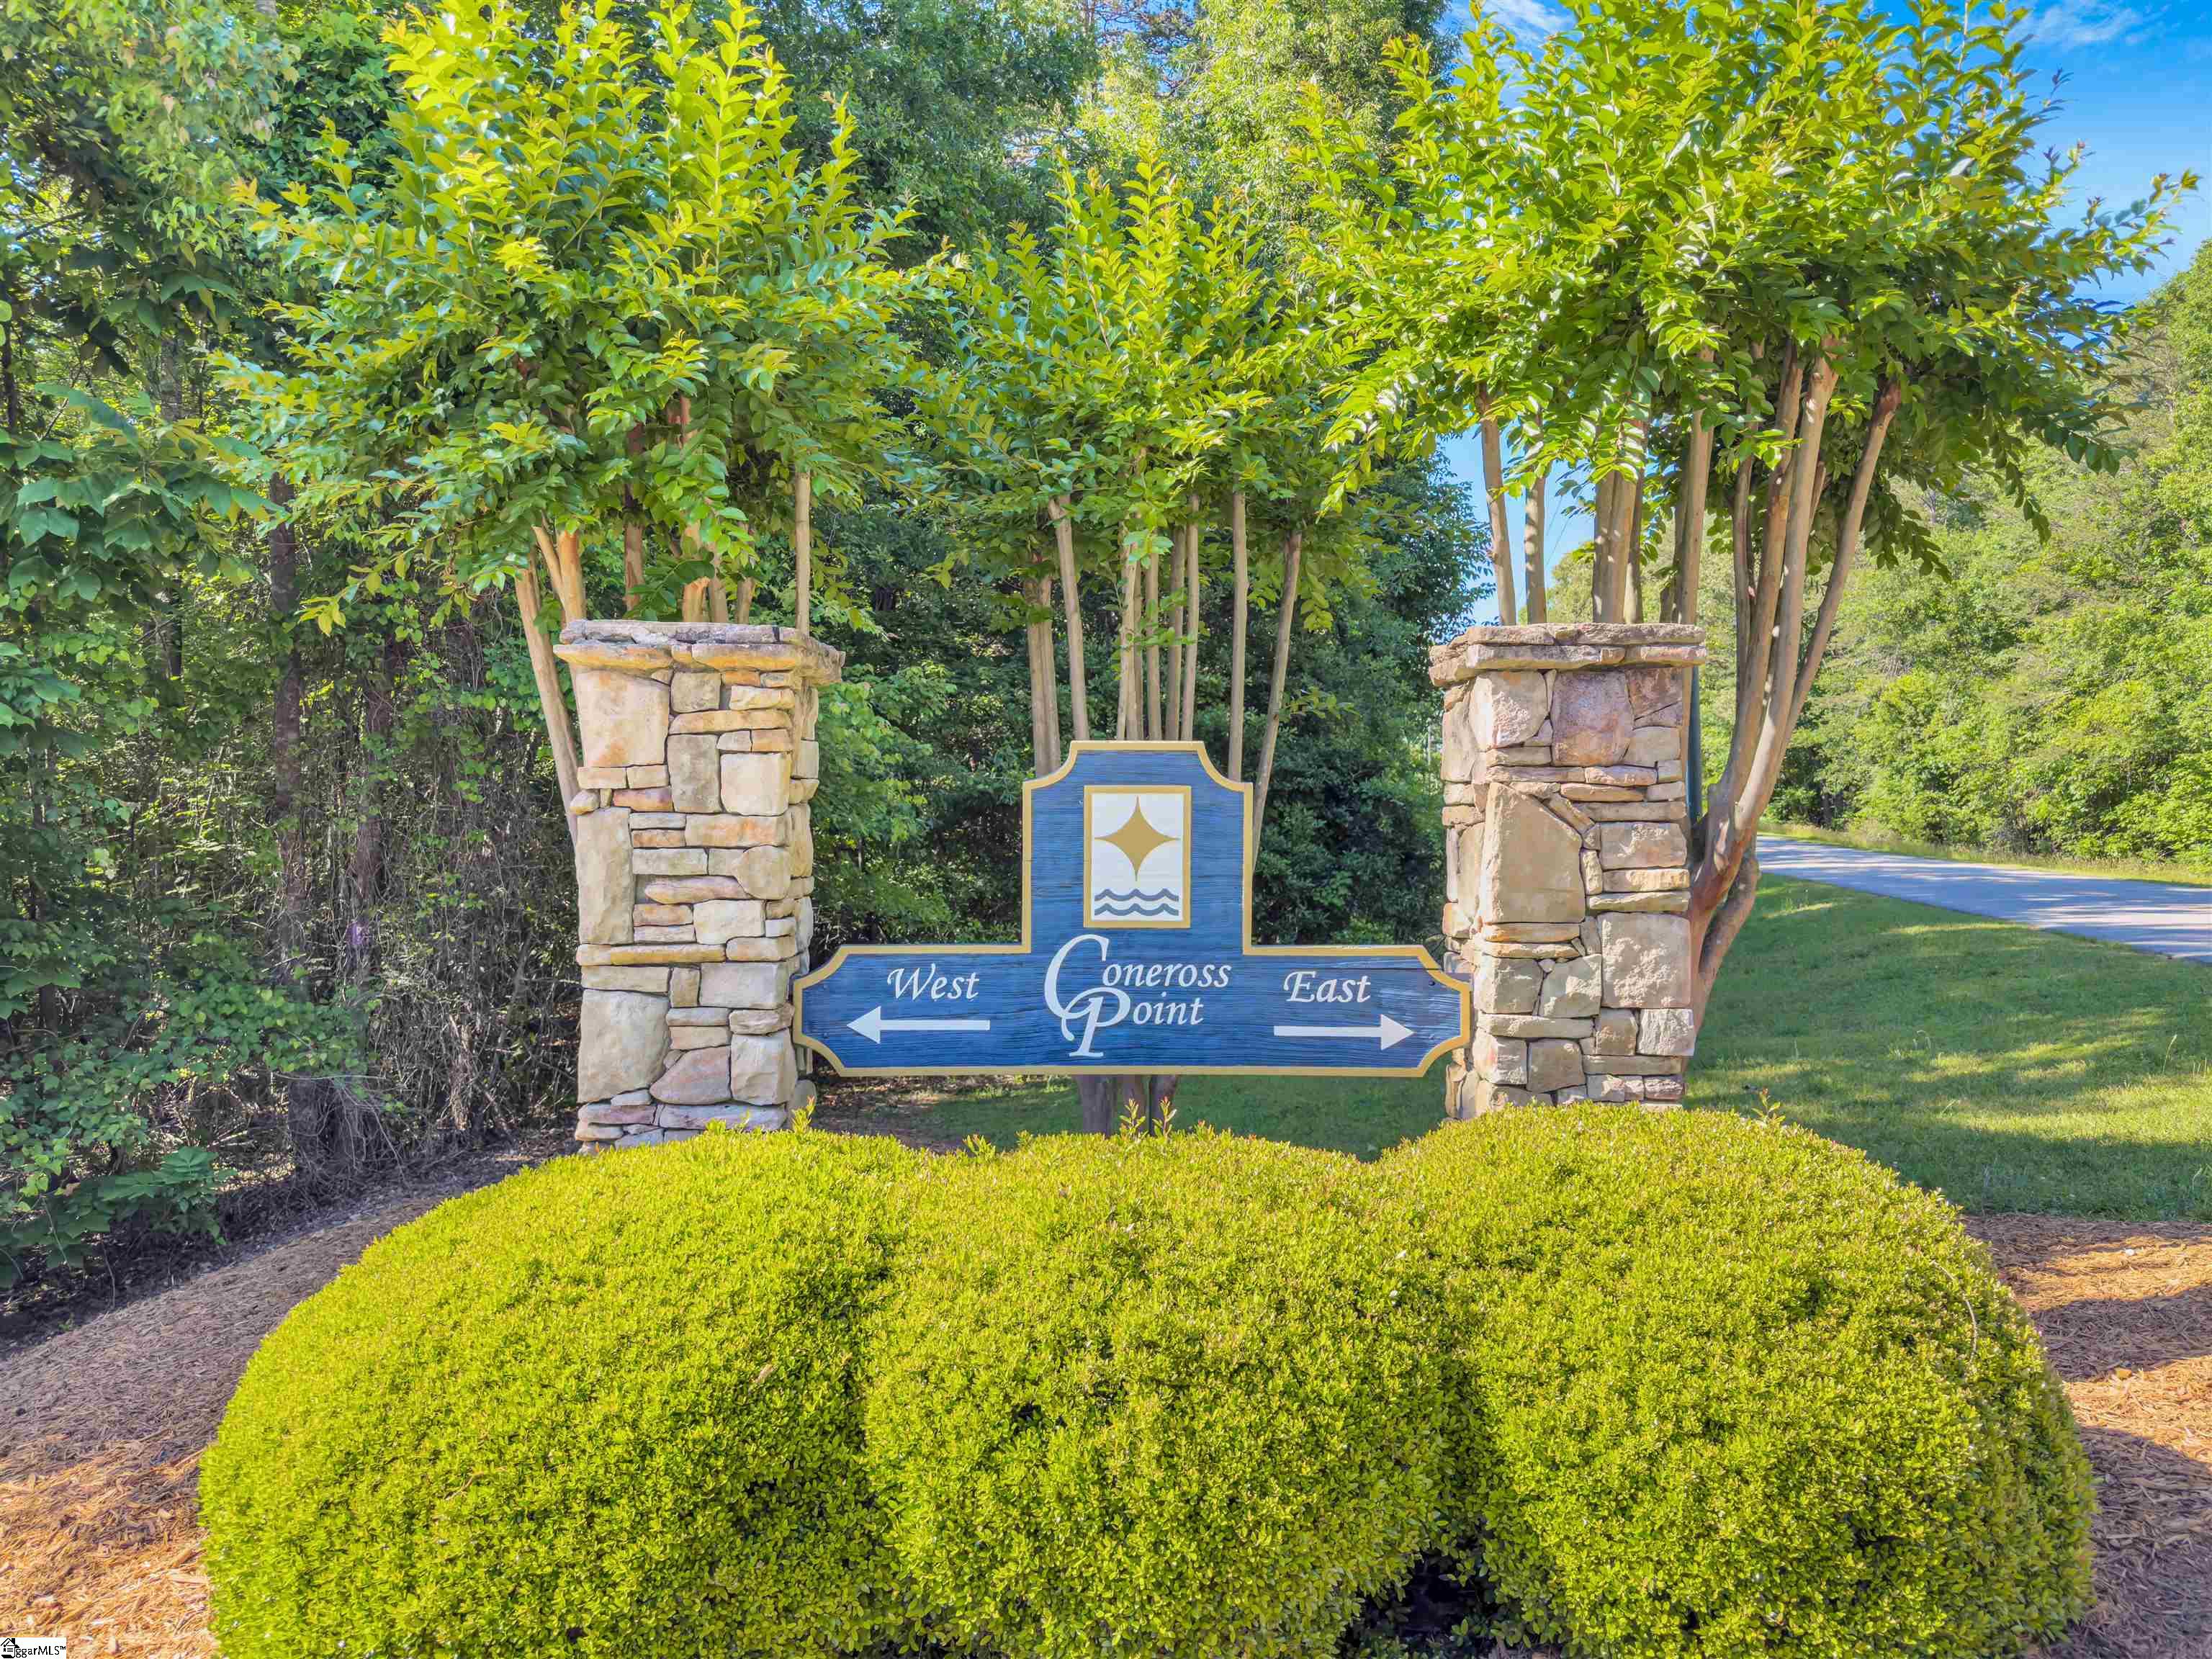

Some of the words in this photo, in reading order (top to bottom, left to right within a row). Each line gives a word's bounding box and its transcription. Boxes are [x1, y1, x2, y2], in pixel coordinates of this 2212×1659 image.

[886, 963, 980, 1000] West
[1044, 934, 1232, 1019] Coneross
[1284, 971, 1372, 1003] East
[1061, 987, 1205, 1057] Point
